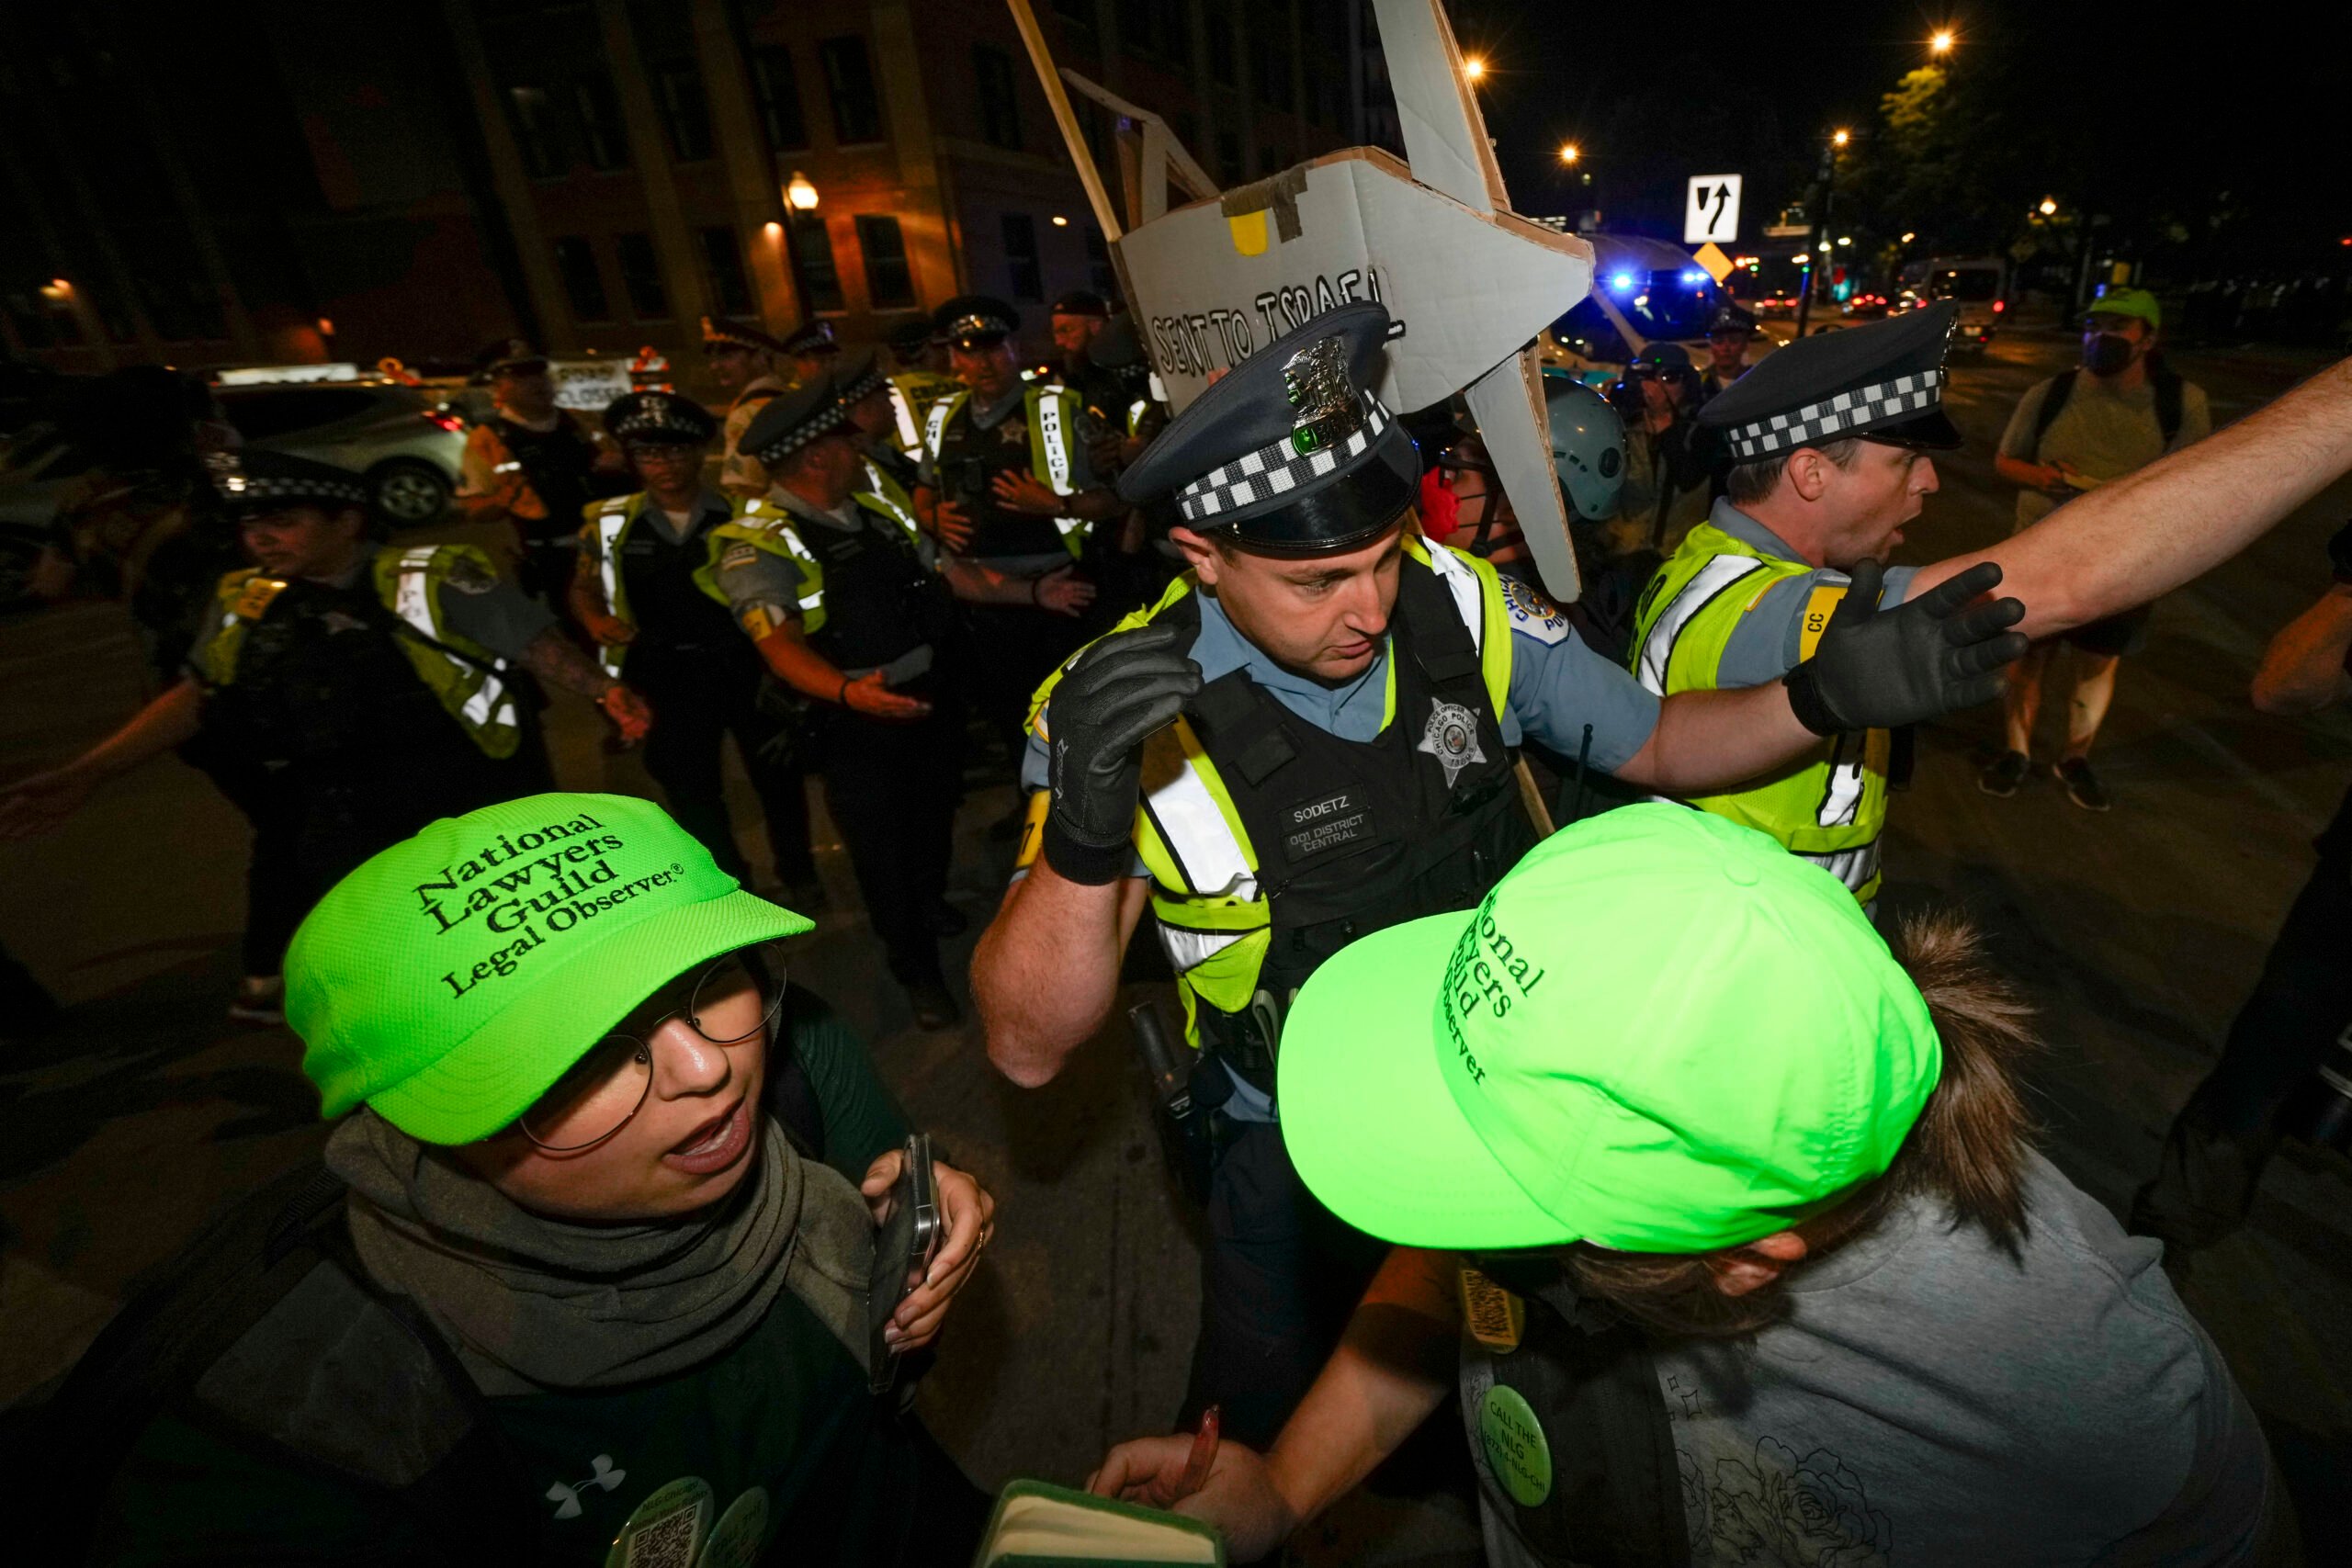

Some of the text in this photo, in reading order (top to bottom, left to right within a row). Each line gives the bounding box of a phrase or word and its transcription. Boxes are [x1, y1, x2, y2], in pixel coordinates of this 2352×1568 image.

[1152, 313, 1213, 378] SENT
[1209, 308, 1253, 368] TO
[1044, 412, 1066, 479] POLICE
[1807, 613, 1825, 633] CC
[1441, 704, 1466, 714] OFFICER
[1433, 713, 1475, 755] CHICAGO POLICE
[1290, 813, 1364, 846] 001 DISTRICT
[1293, 795, 1351, 823] SODETZ
[413, 813, 606, 910] National
[1301, 829, 1359, 852] CENTRAL
[423, 835, 624, 935] Lawyers
[486, 860, 619, 933] Guild
[440, 925, 546, 999] Legal
[1490, 1401, 1537, 1450] CALL THE
[1501, 1429, 1525, 1460] NLG
[643, 1496, 663, 1511] NLG
